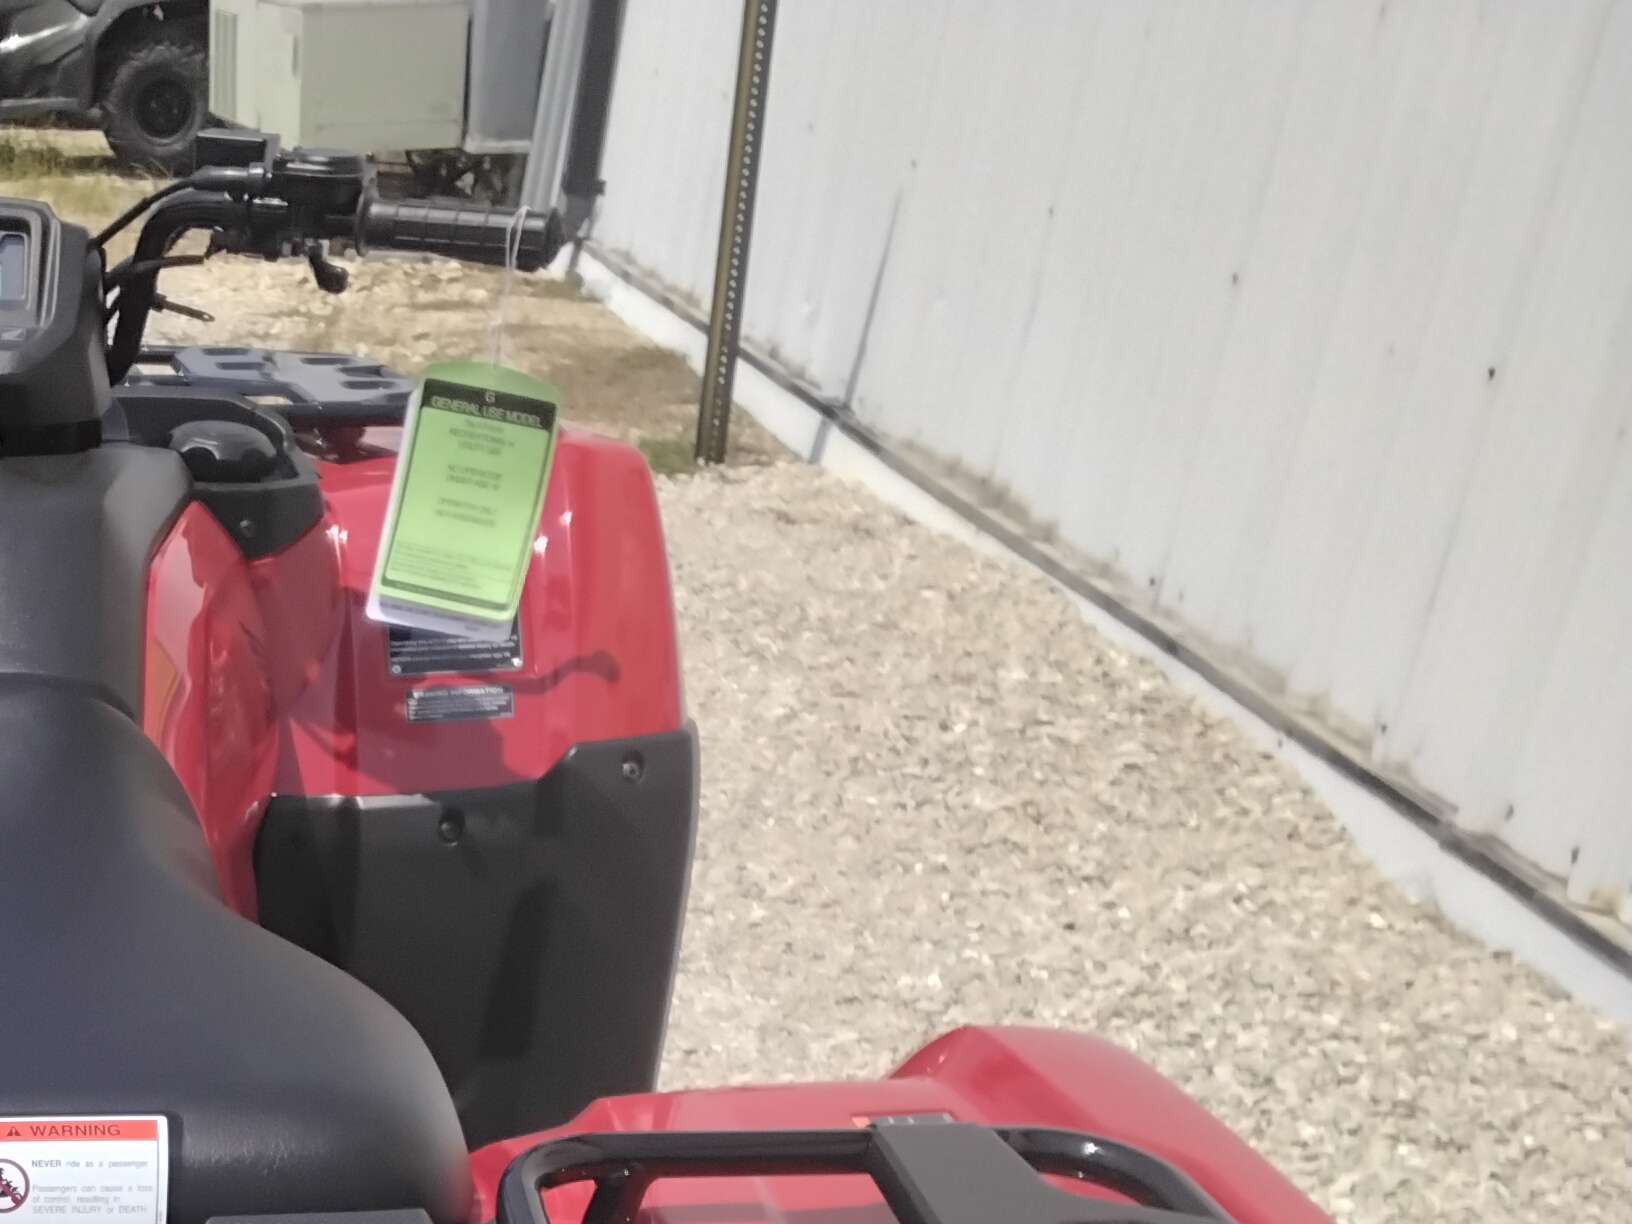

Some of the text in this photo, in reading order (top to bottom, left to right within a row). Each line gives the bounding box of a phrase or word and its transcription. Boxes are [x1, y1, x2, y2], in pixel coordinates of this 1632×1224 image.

[483, 405, 506, 420] USE
[29, 1124, 121, 1137] WARNING
[31, 1160, 61, 1168] NEVER
[66, 1160, 80, 1168] ride
[32, 1184, 77, 1195] Passengers
[81, 1185, 96, 1193] can
[100, 1185, 123, 1193] cause
[137, 1184, 154, 1193] loss
[32, 1195, 40, 1204] of
[77, 1195, 110, 1205] resulting
[32, 1205, 67, 1214] SEVERE
[71, 1205, 102, 1214] INJURY
[106, 1206, 114, 1214] or
